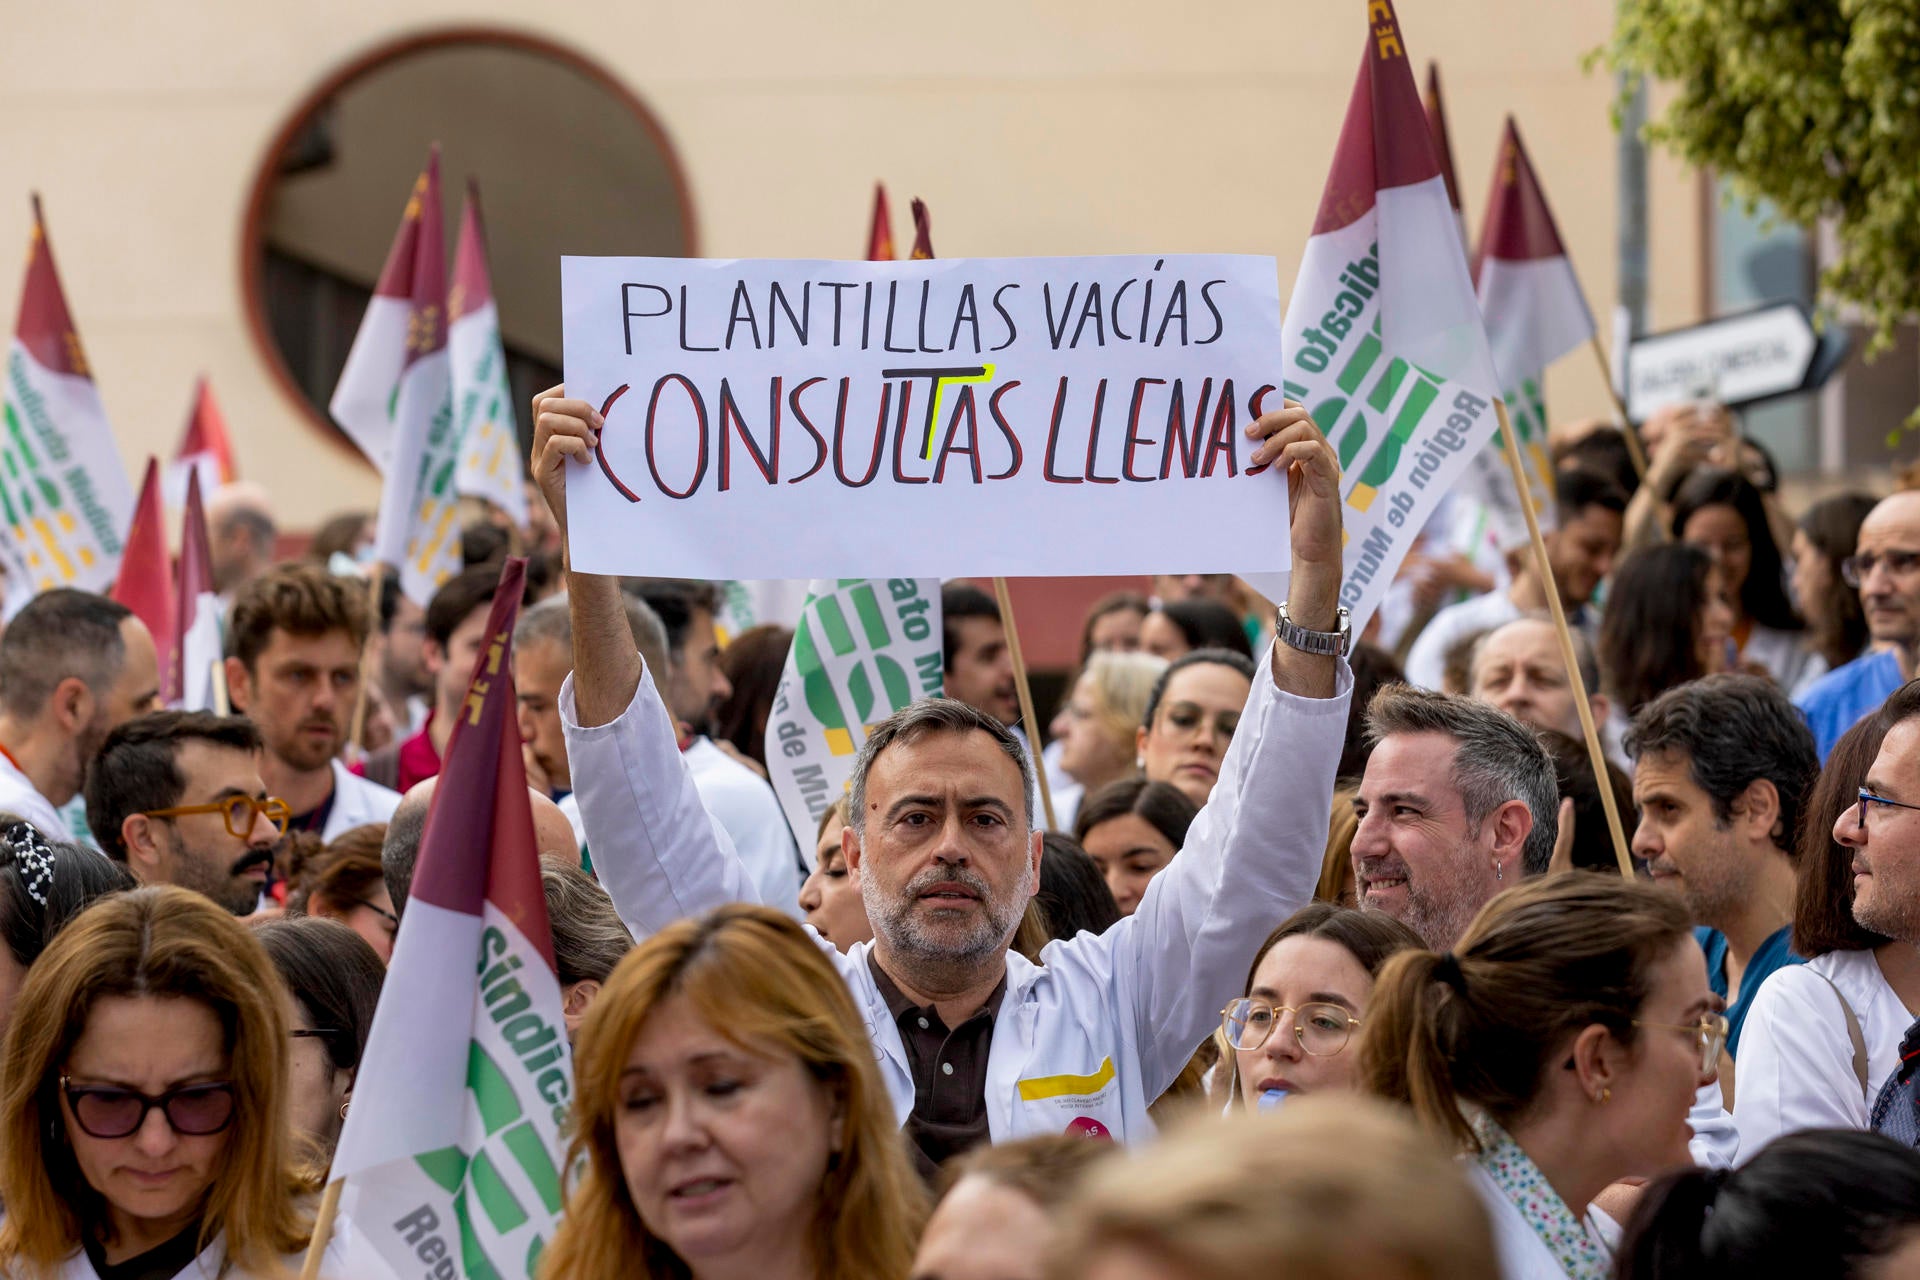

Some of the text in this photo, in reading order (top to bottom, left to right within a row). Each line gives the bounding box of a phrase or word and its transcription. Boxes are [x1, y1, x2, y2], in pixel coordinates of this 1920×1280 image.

[621, 259, 1226, 355] PLANTILLAS VACÍAS
[594, 364, 1022, 503] CONSULTAS
[1043, 376, 1277, 484] LLENAS
[777, 721, 806, 758] de
